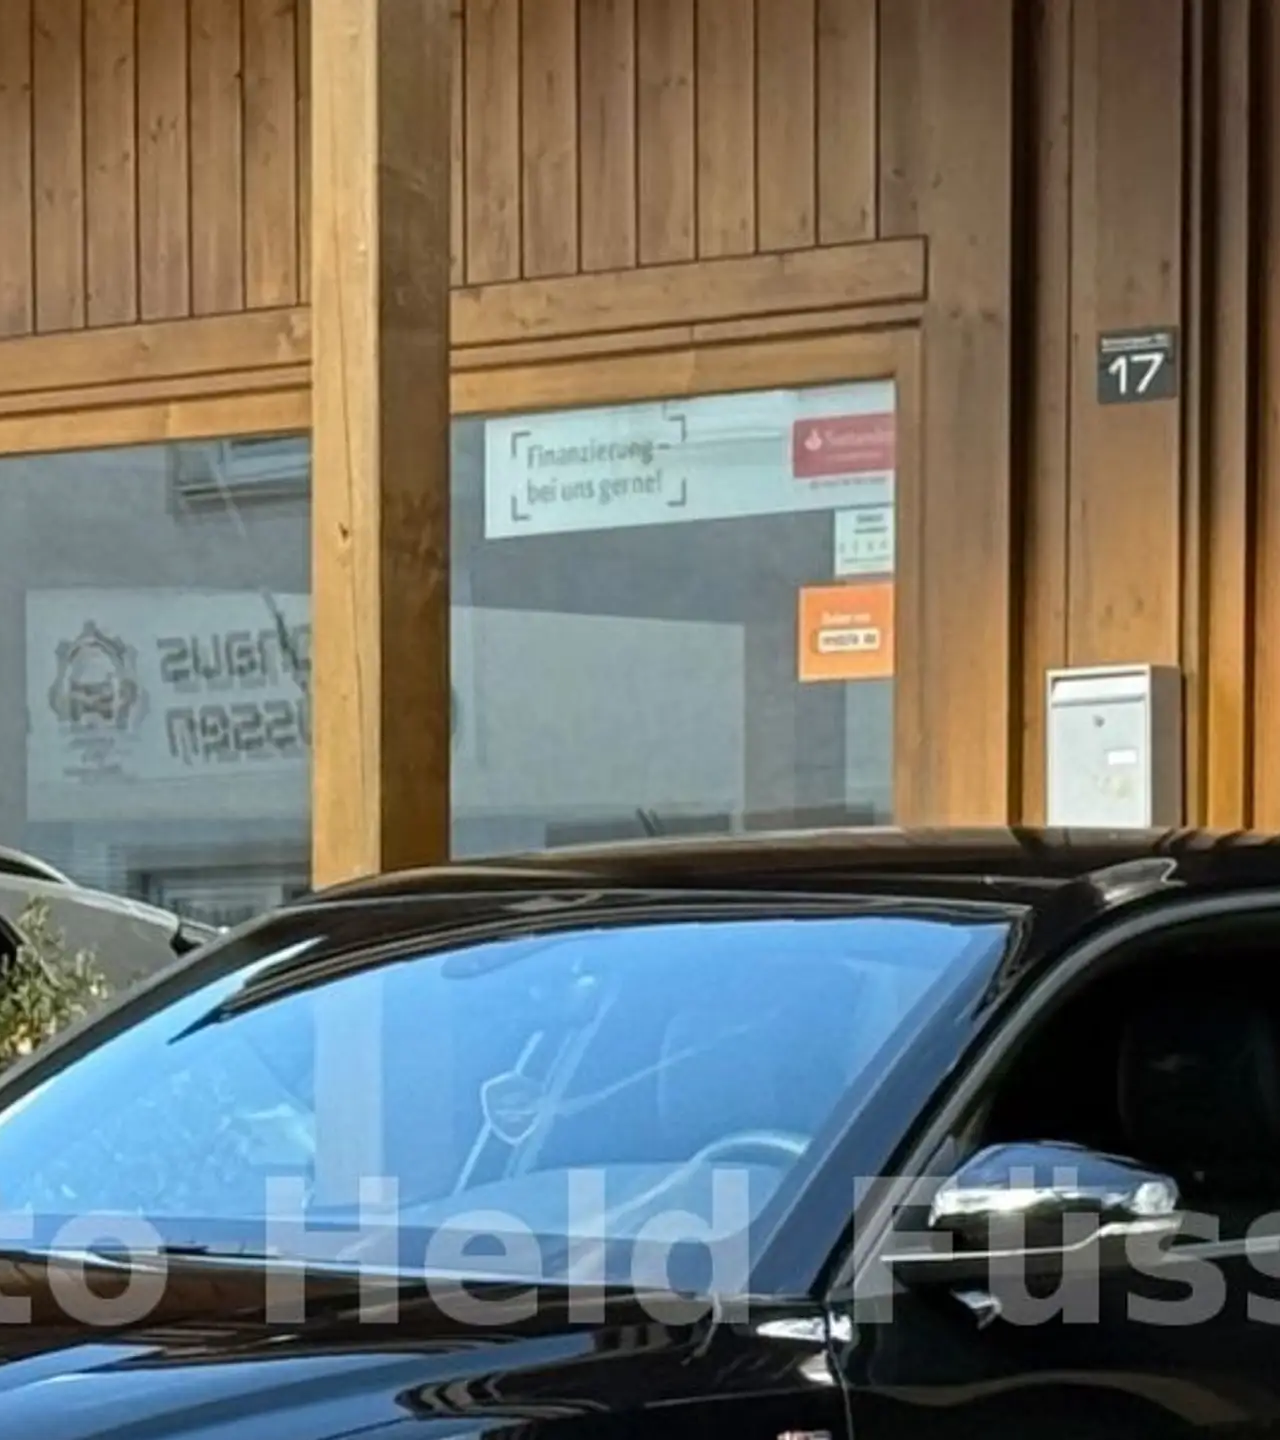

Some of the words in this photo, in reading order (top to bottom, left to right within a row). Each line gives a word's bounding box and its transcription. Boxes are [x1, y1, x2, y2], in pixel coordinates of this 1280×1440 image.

[1108, 352, 1165, 395] 17
[526, 438, 654, 470] Finanzierung
[526, 477, 558, 505] bei
[561, 478, 595, 502] uns
